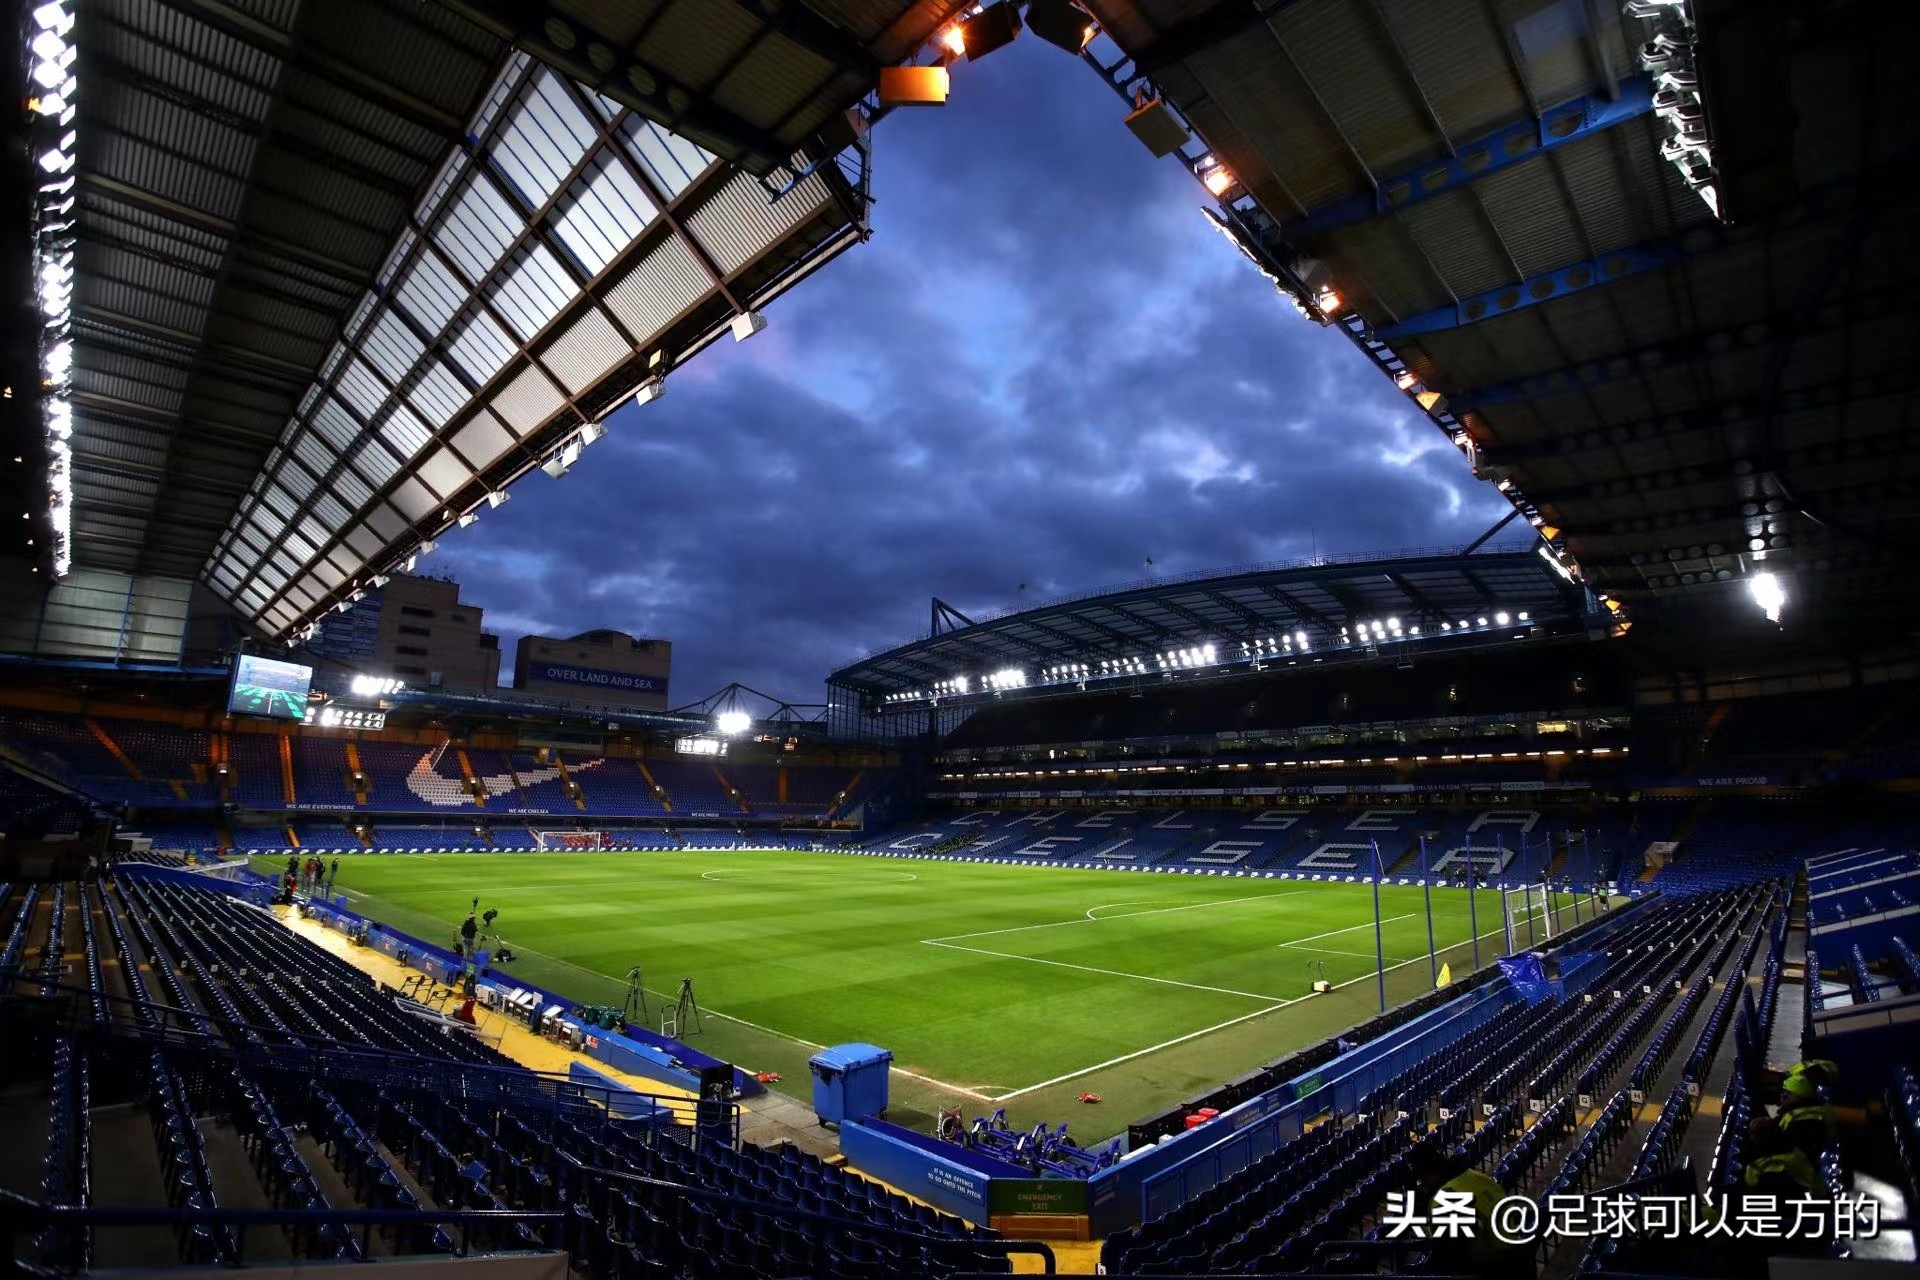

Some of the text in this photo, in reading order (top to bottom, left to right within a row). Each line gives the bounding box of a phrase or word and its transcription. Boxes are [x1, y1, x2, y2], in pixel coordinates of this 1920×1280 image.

[547, 668, 653, 689] OVER LAND AND SEA
[1698, 778, 1713, 786] WE
[1735, 776, 1767, 785] PROUD
[950, 809, 1542, 833] CHELSEA
[889, 833, 1515, 875] CHELSEA
[953, 1175, 974, 1189] OFFENCE
[956, 1184, 967, 1194] THE
[966, 1188, 982, 1200] PITCH
[1016, 1193, 1063, 1201] EMERGENCY
[1031, 1202, 1049, 1210] EXIT
